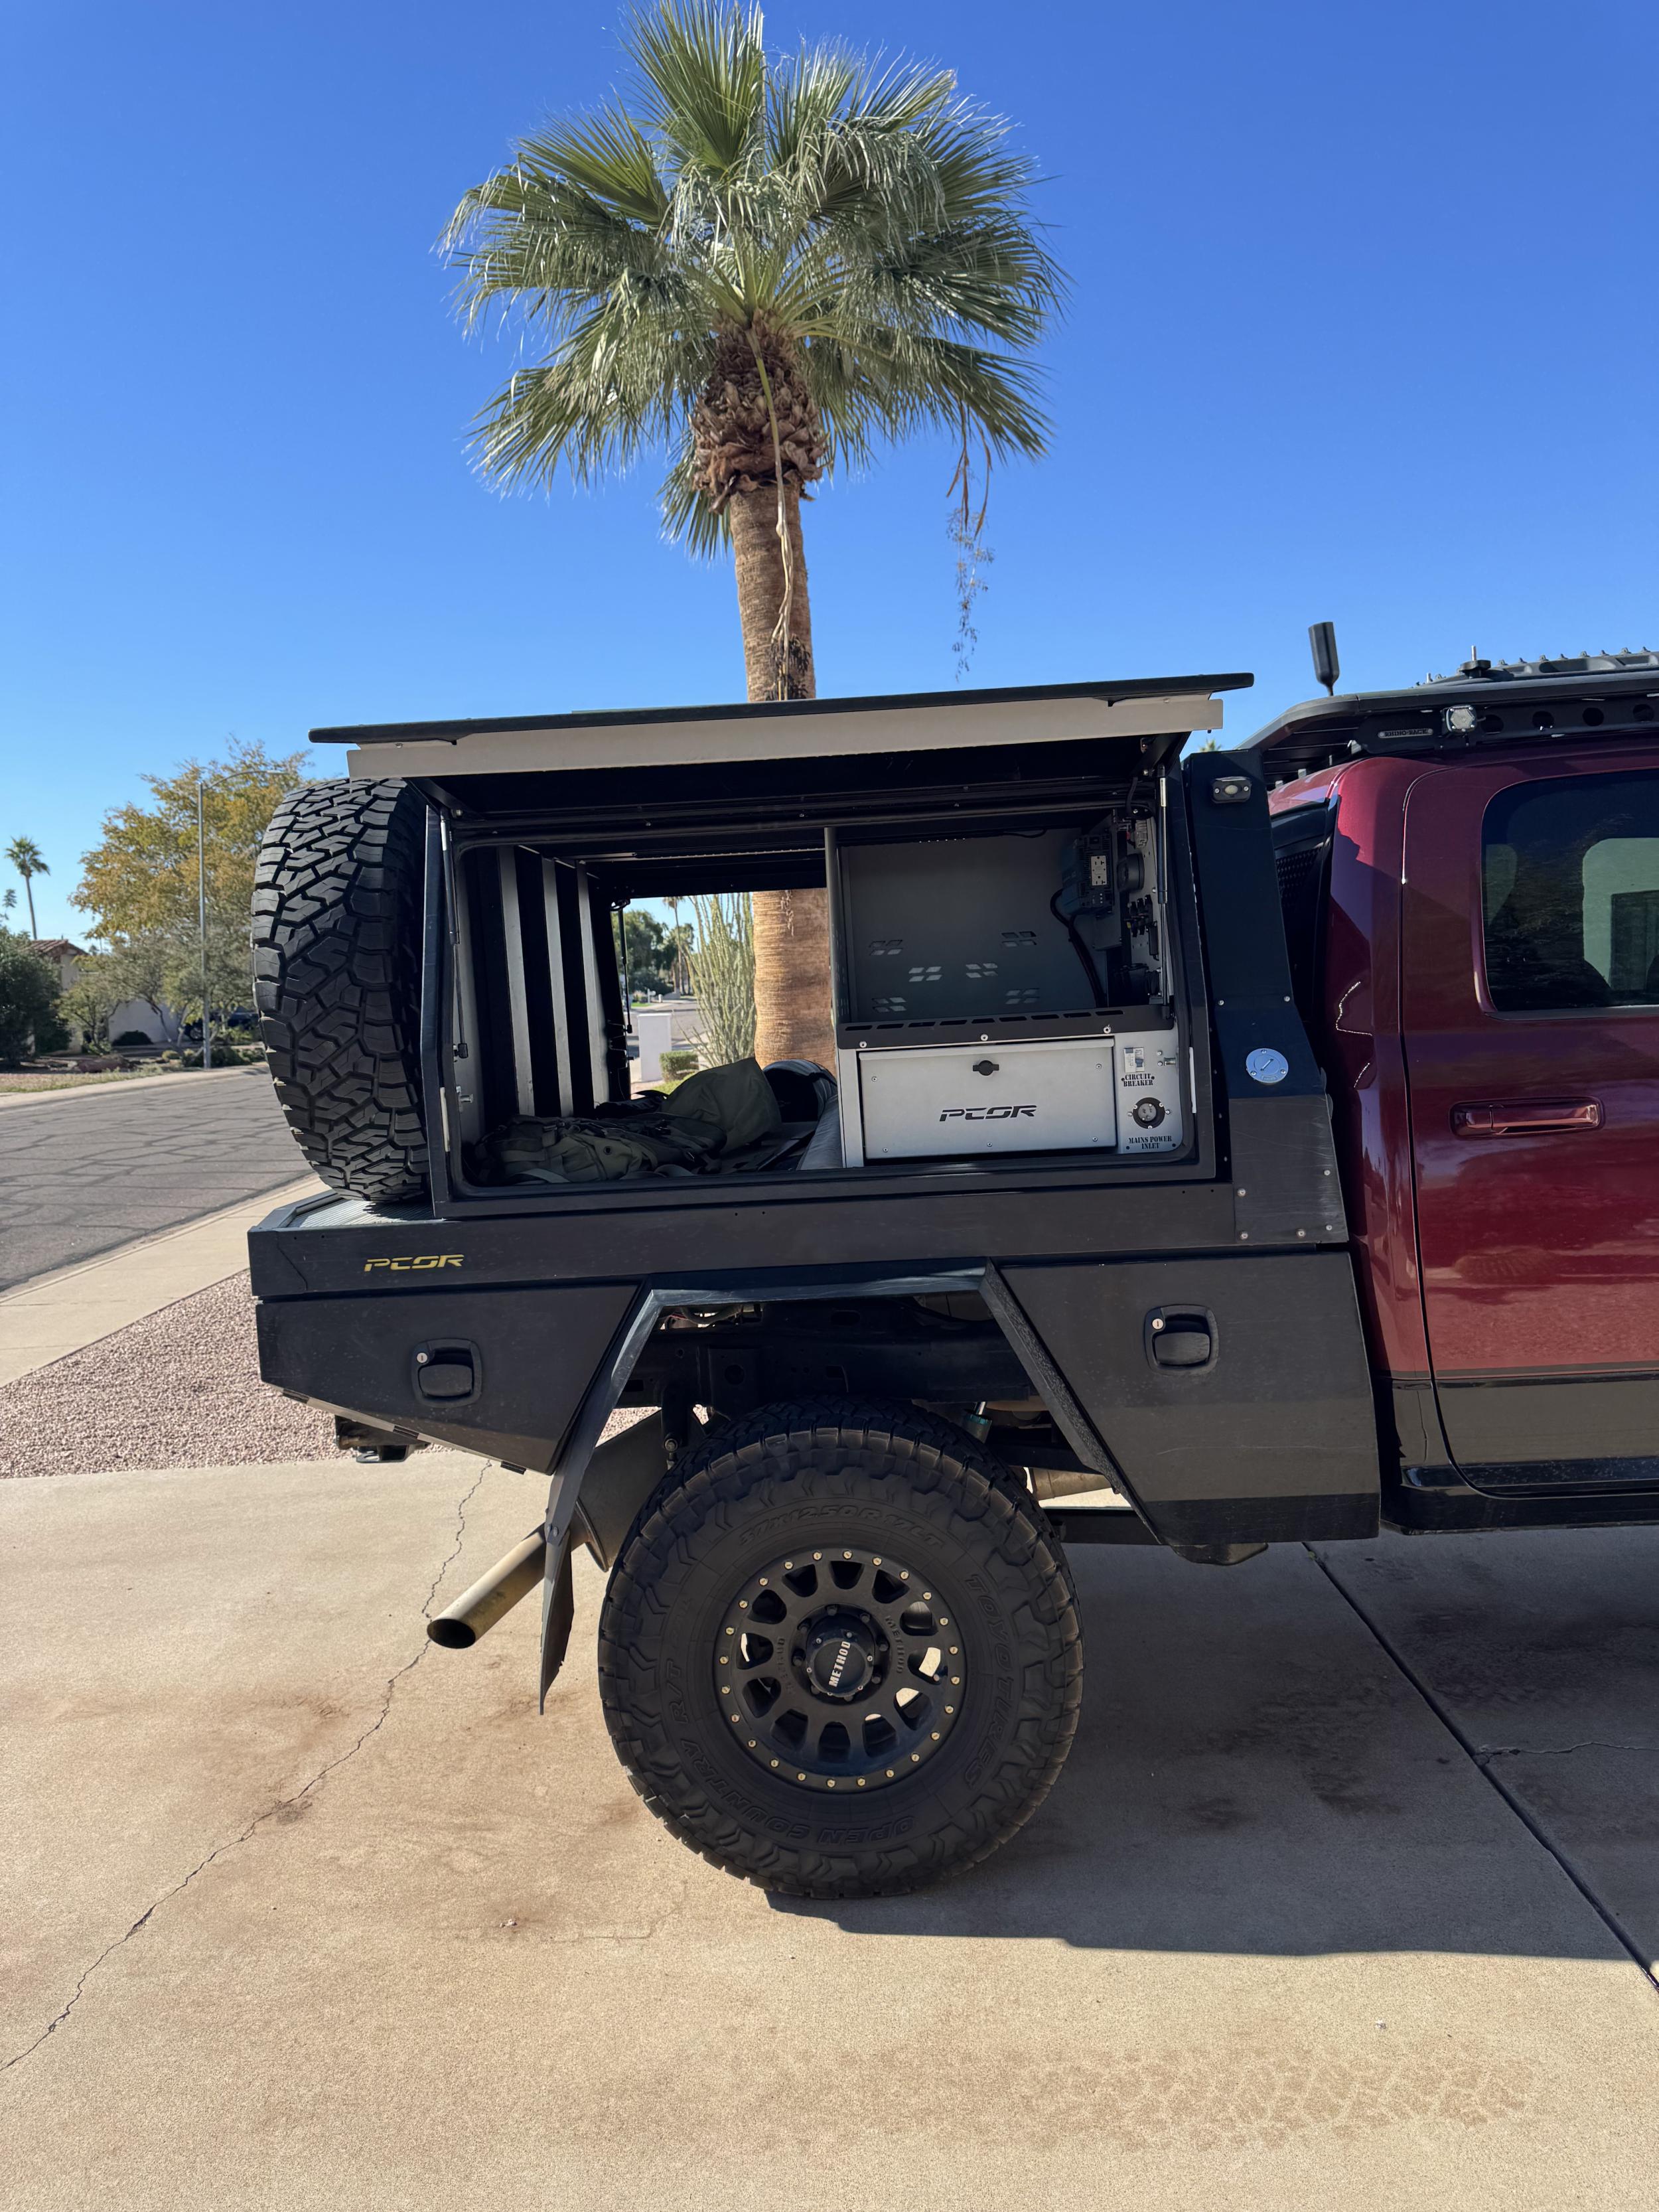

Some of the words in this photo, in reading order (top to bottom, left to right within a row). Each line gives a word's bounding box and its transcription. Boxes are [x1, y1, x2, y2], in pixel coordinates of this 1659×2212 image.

[828, 1641, 851, 1687] METHOD
[680, 1739, 810, 1840] COUNTRY
[817, 1815, 918, 1844] OPEN
